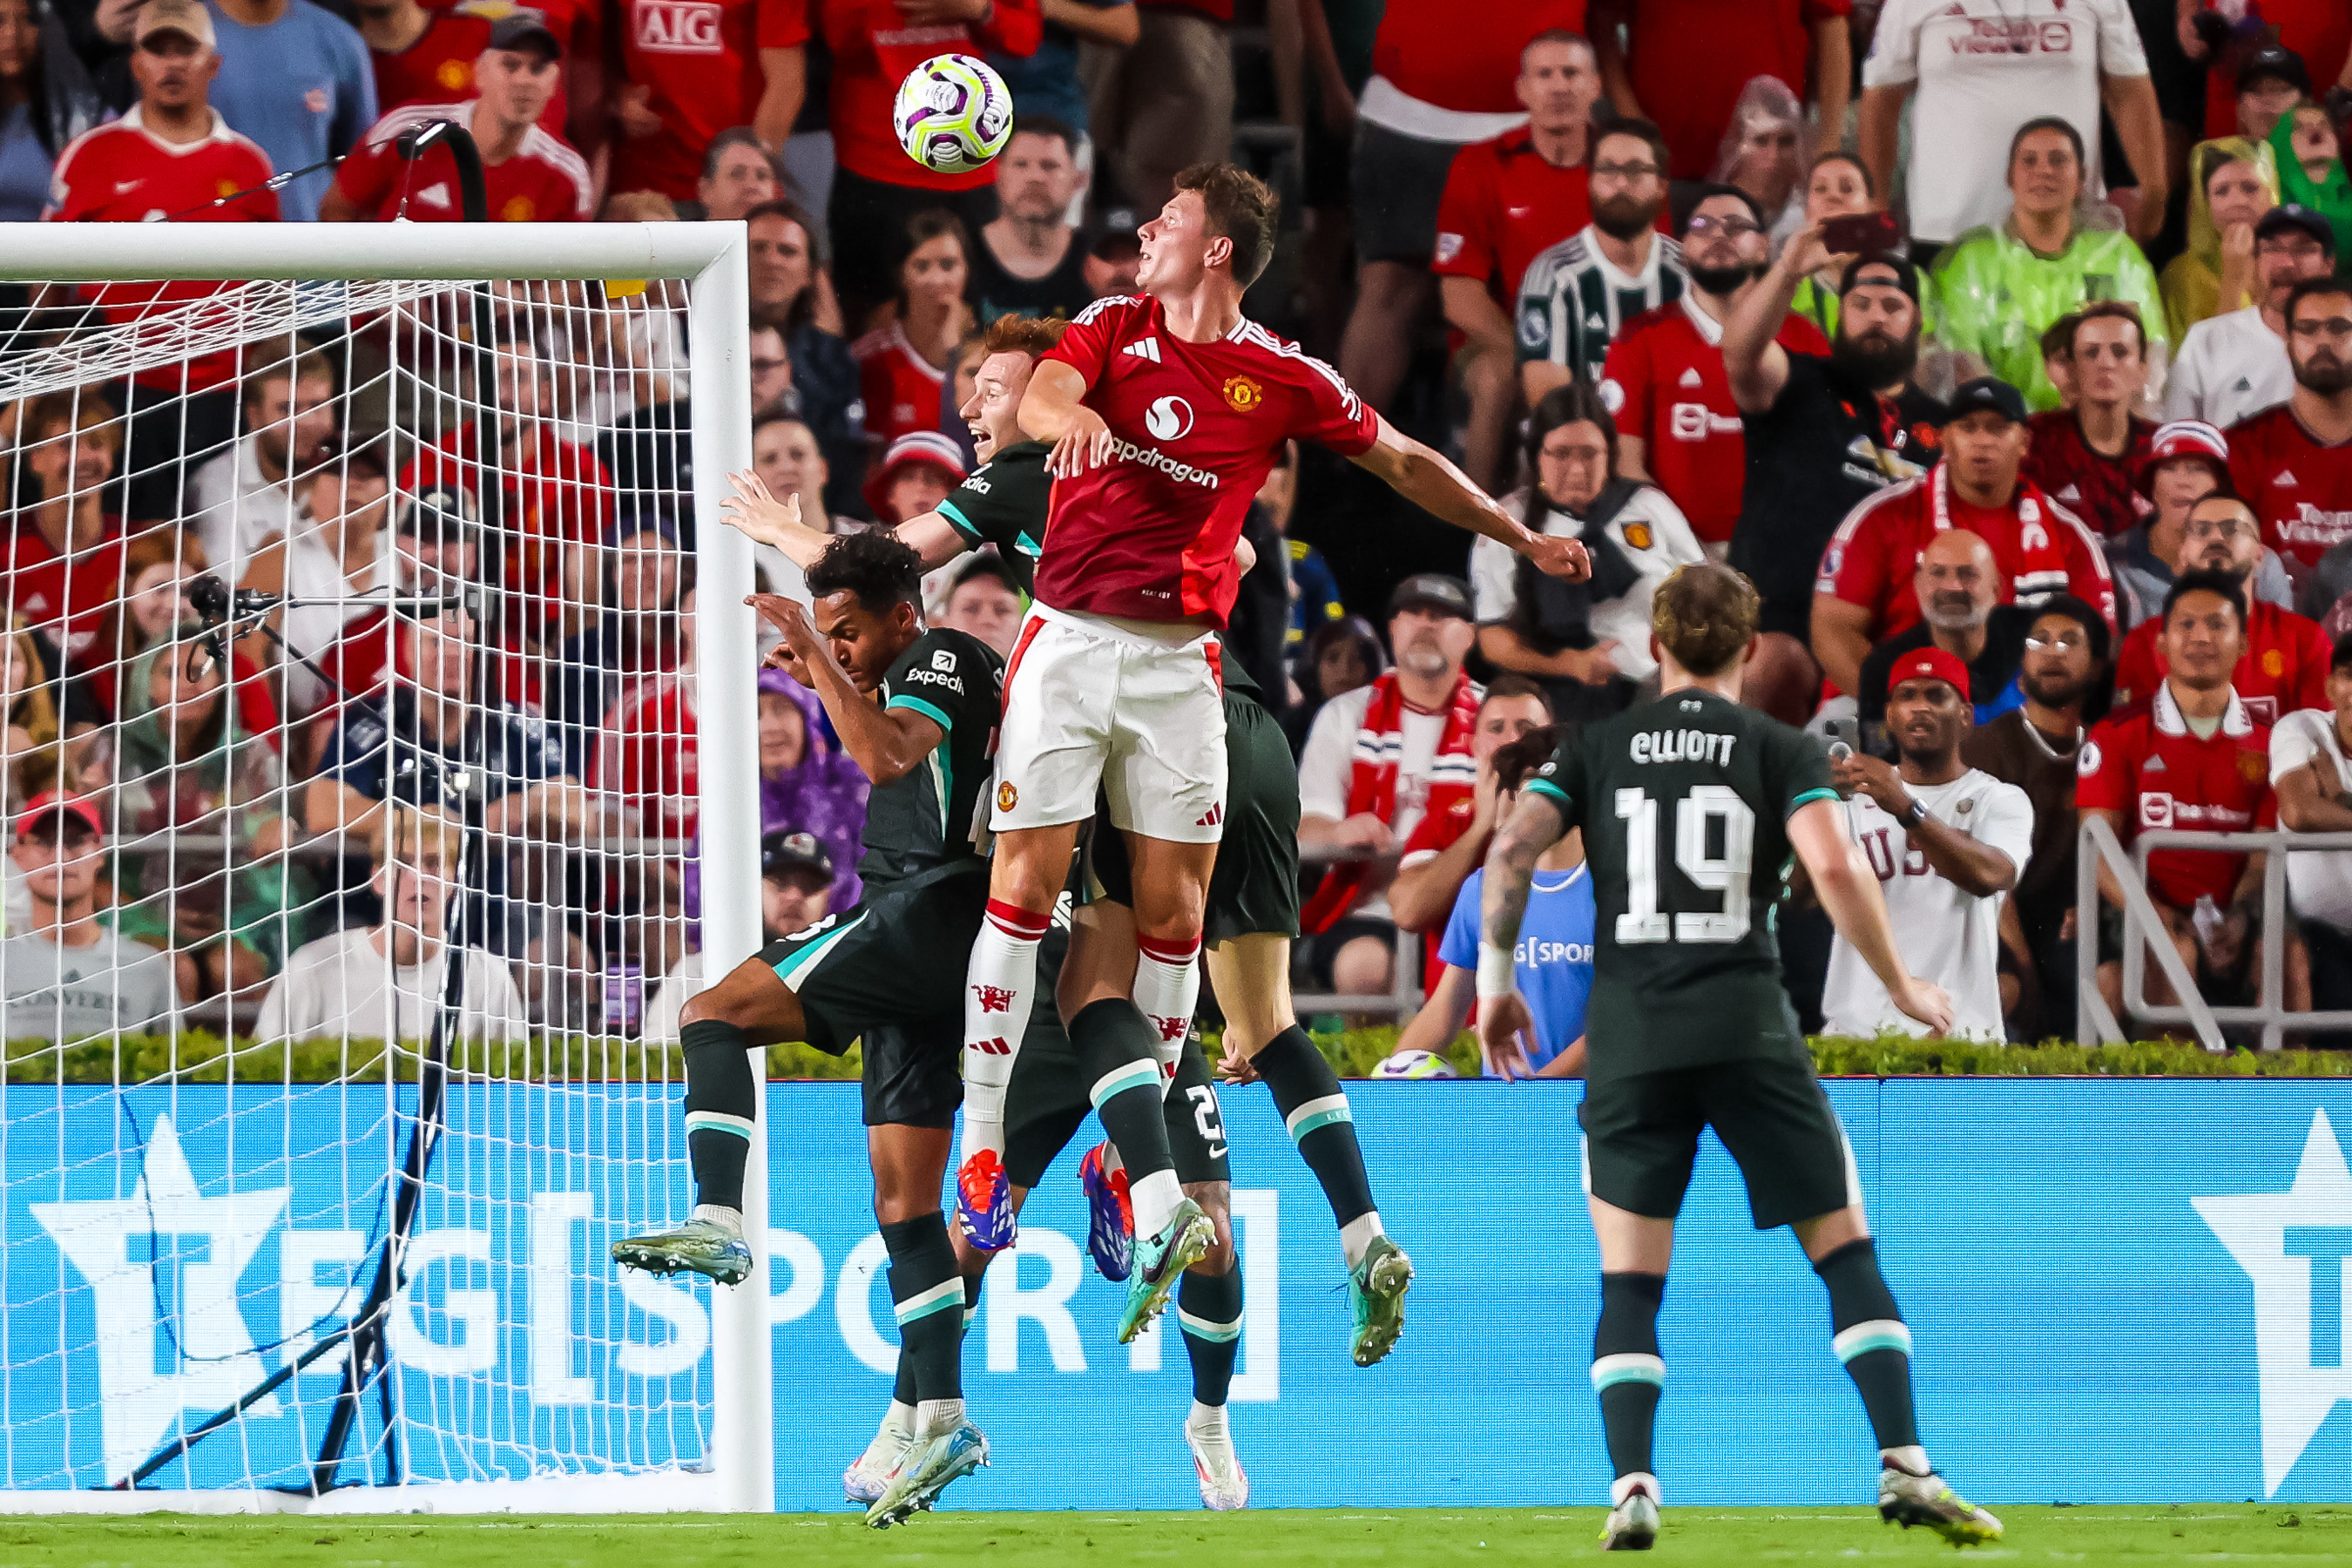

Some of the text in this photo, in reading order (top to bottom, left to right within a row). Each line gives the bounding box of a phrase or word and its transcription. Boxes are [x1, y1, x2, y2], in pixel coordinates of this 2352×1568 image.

[642, 5, 716, 44] AIG
[1110, 436, 1219, 490] apdragon
[960, 474, 992, 496] edia
[905, 667, 964, 697] Expedi
[1614, 785, 1756, 945] 19
